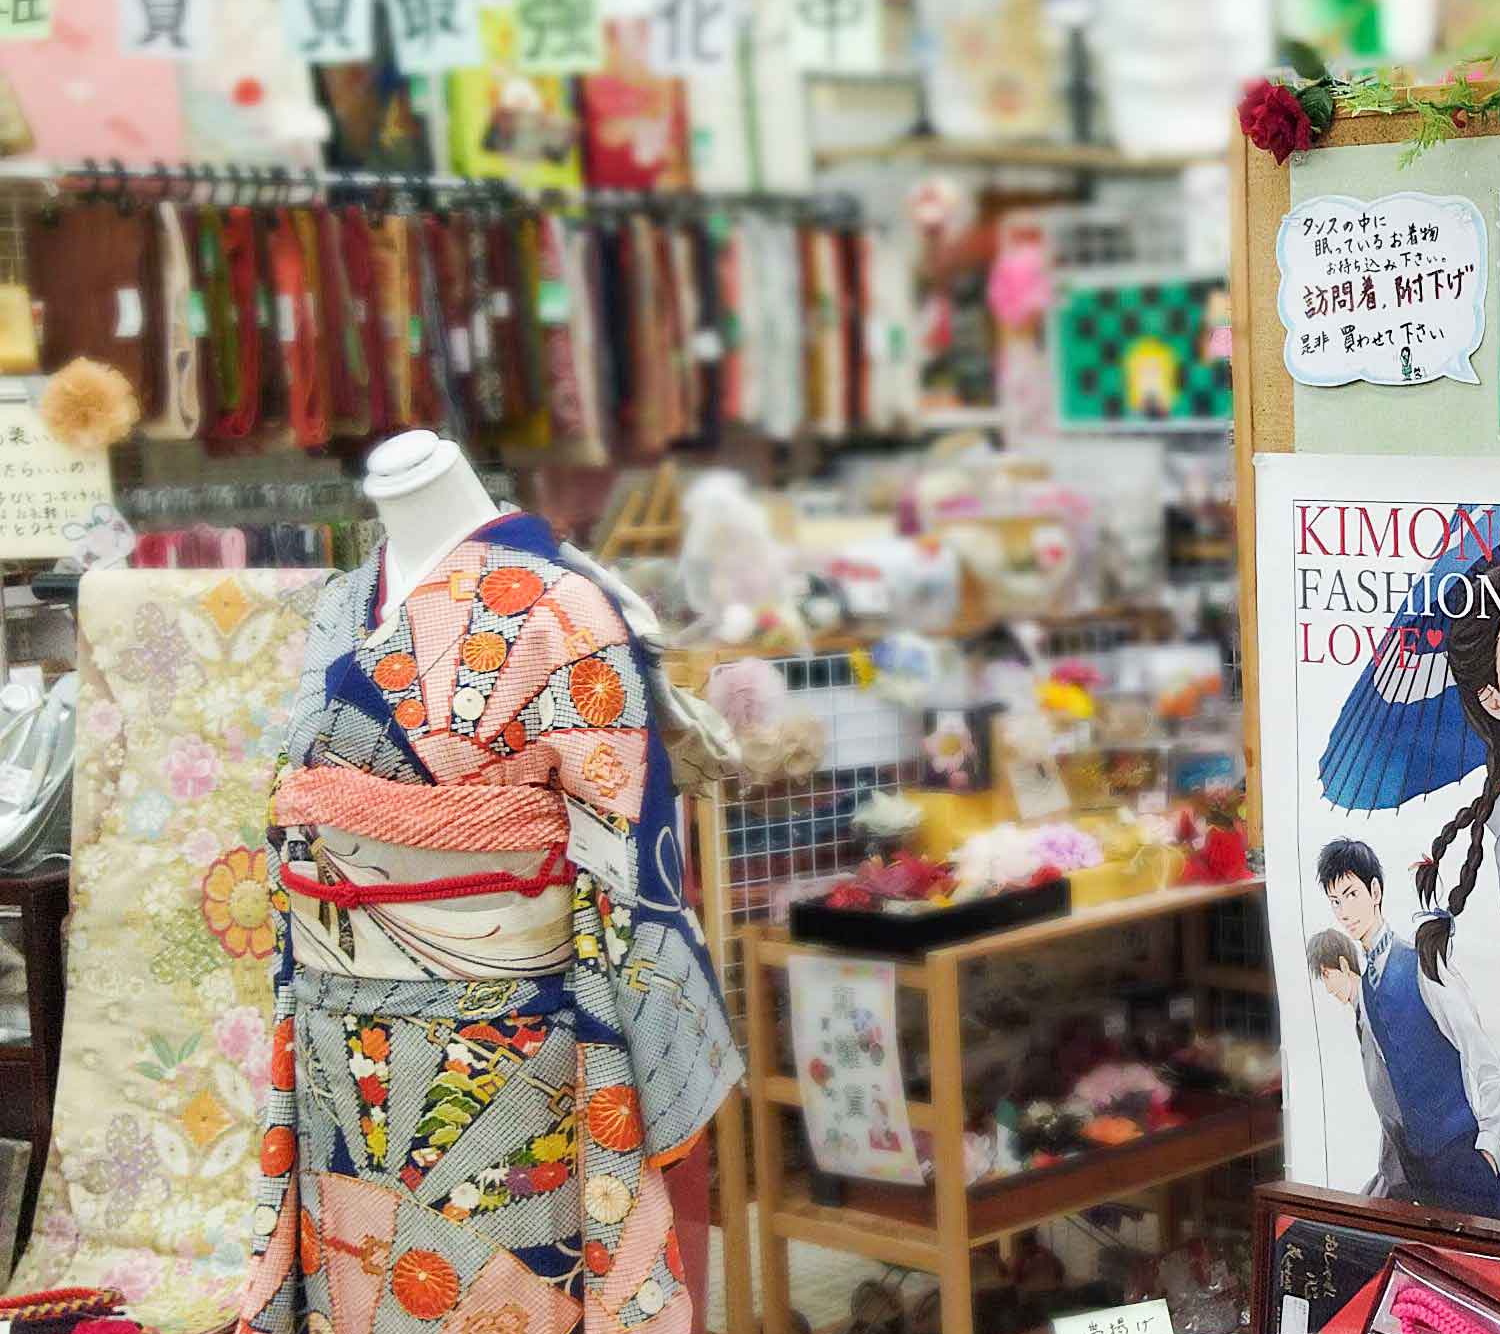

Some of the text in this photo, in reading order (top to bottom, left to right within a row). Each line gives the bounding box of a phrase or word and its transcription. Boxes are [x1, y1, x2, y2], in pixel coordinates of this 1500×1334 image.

[1303, 213, 1387, 236] タンスの中に
[1314, 222, 1439, 257] 眠っているお着物
[1299, 623, 1422, 671] LOVE
